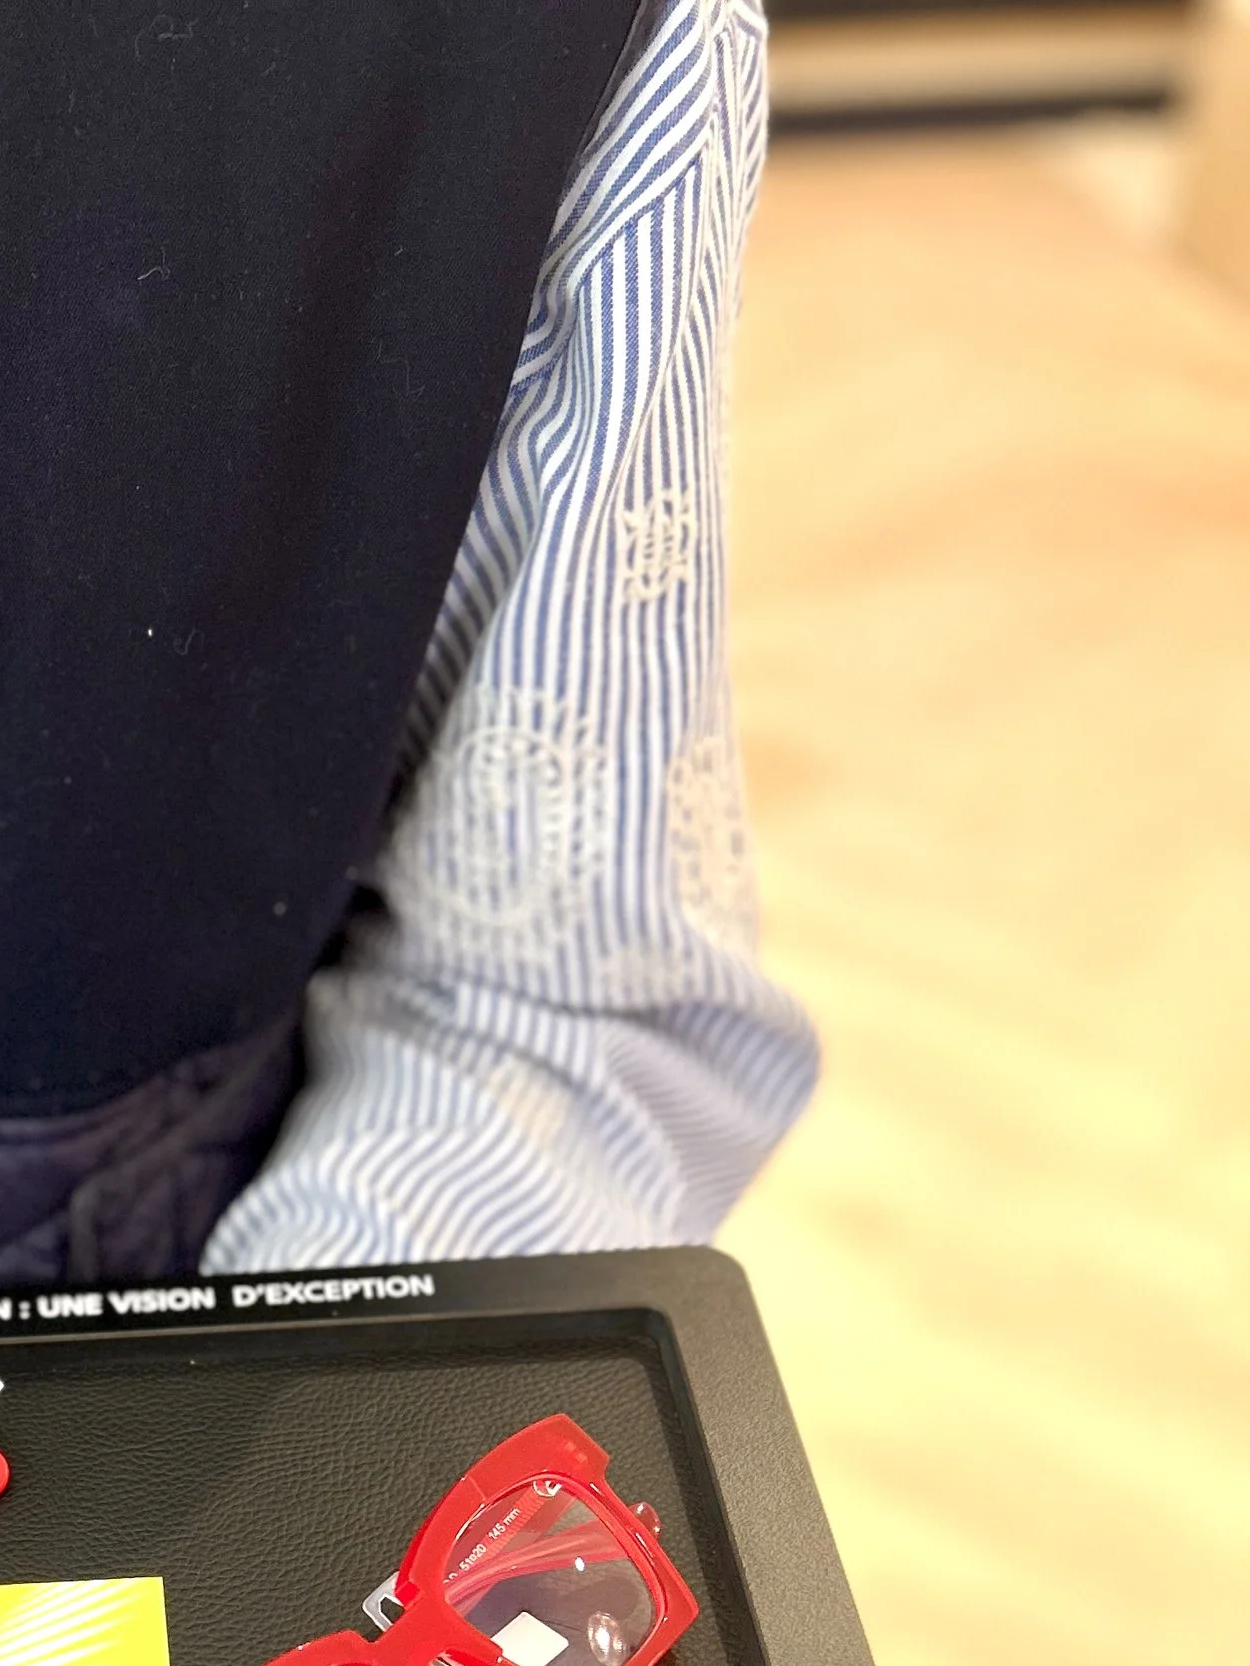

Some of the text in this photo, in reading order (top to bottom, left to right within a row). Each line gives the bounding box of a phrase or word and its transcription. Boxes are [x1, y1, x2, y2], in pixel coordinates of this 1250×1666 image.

[36, 1293, 103, 1319] UNE
[106, 1286, 216, 1315] VISION
[231, 1273, 435, 1308] D'EXCEPTION
